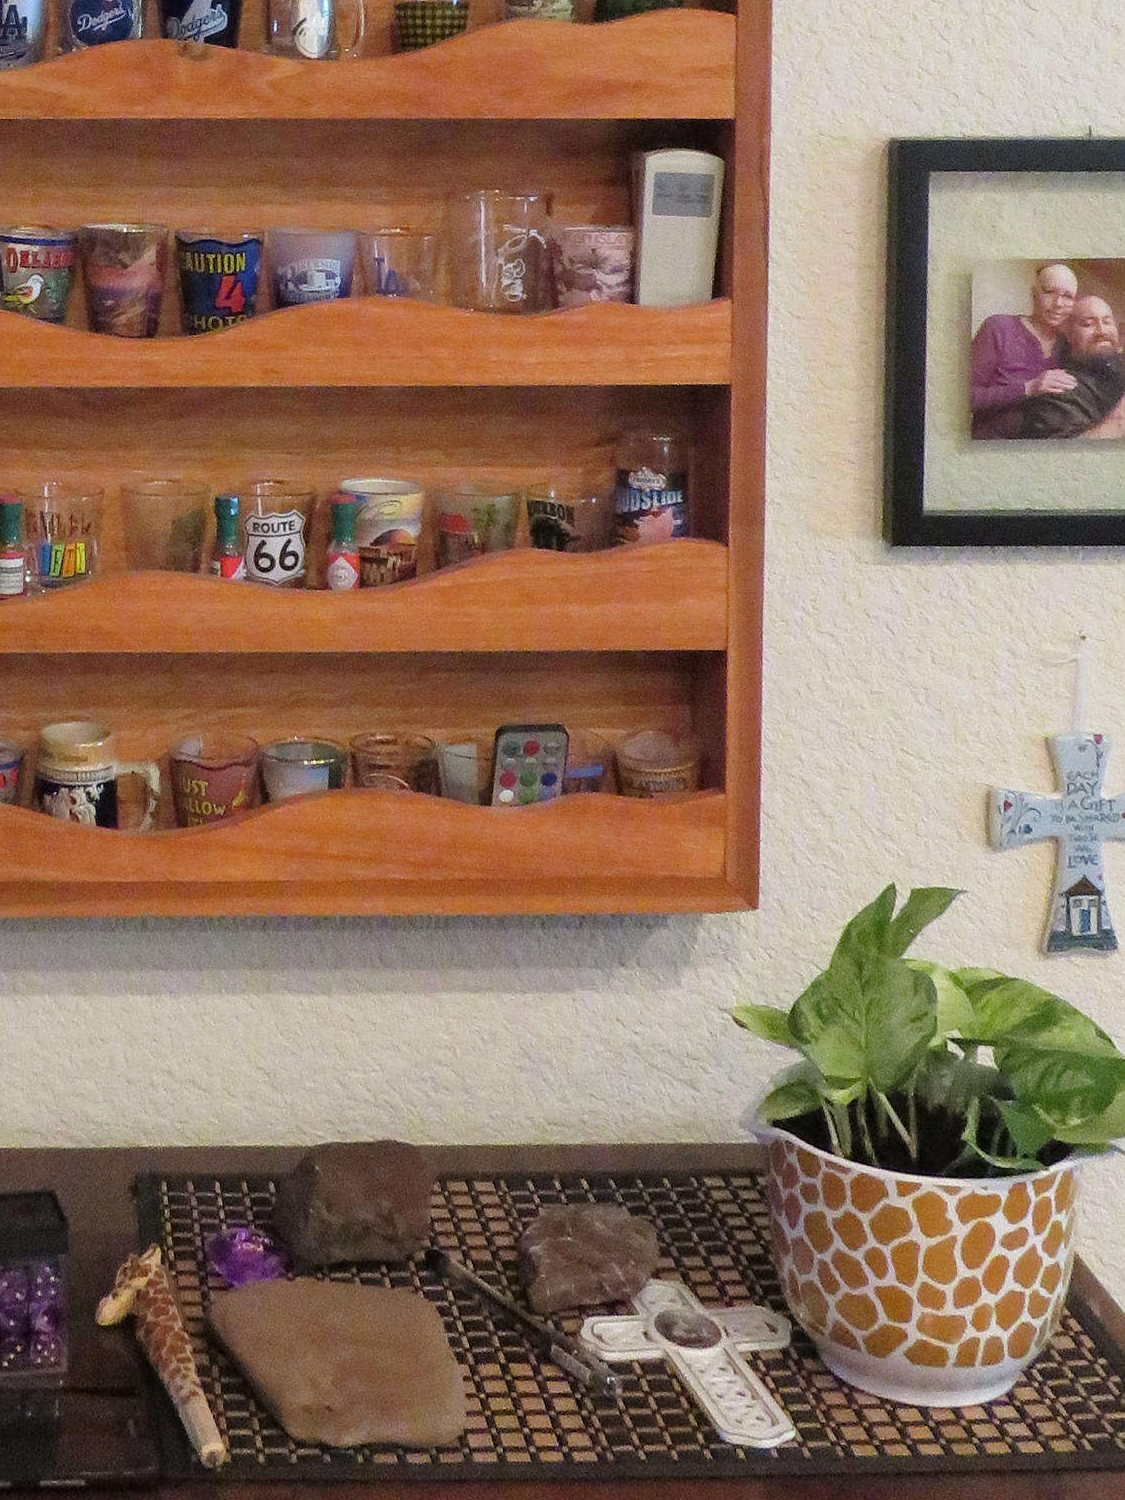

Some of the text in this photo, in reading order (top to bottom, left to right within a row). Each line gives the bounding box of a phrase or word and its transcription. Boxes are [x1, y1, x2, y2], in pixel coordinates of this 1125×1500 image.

[77, 0, 128, 33] Dodgers
[165, 5, 228, 41] Dodgers
[214, 275, 245, 313] 4
[252, 520, 296, 533] ROUTE
[254, 538, 299, 573] 66
[181, 777, 209, 797] UST
[1067, 781, 1099, 796] DAY
[1067, 800, 1080, 811] A
[1079, 796, 1117, 812] GIFT
[1066, 854, 1099, 869] LOVE
